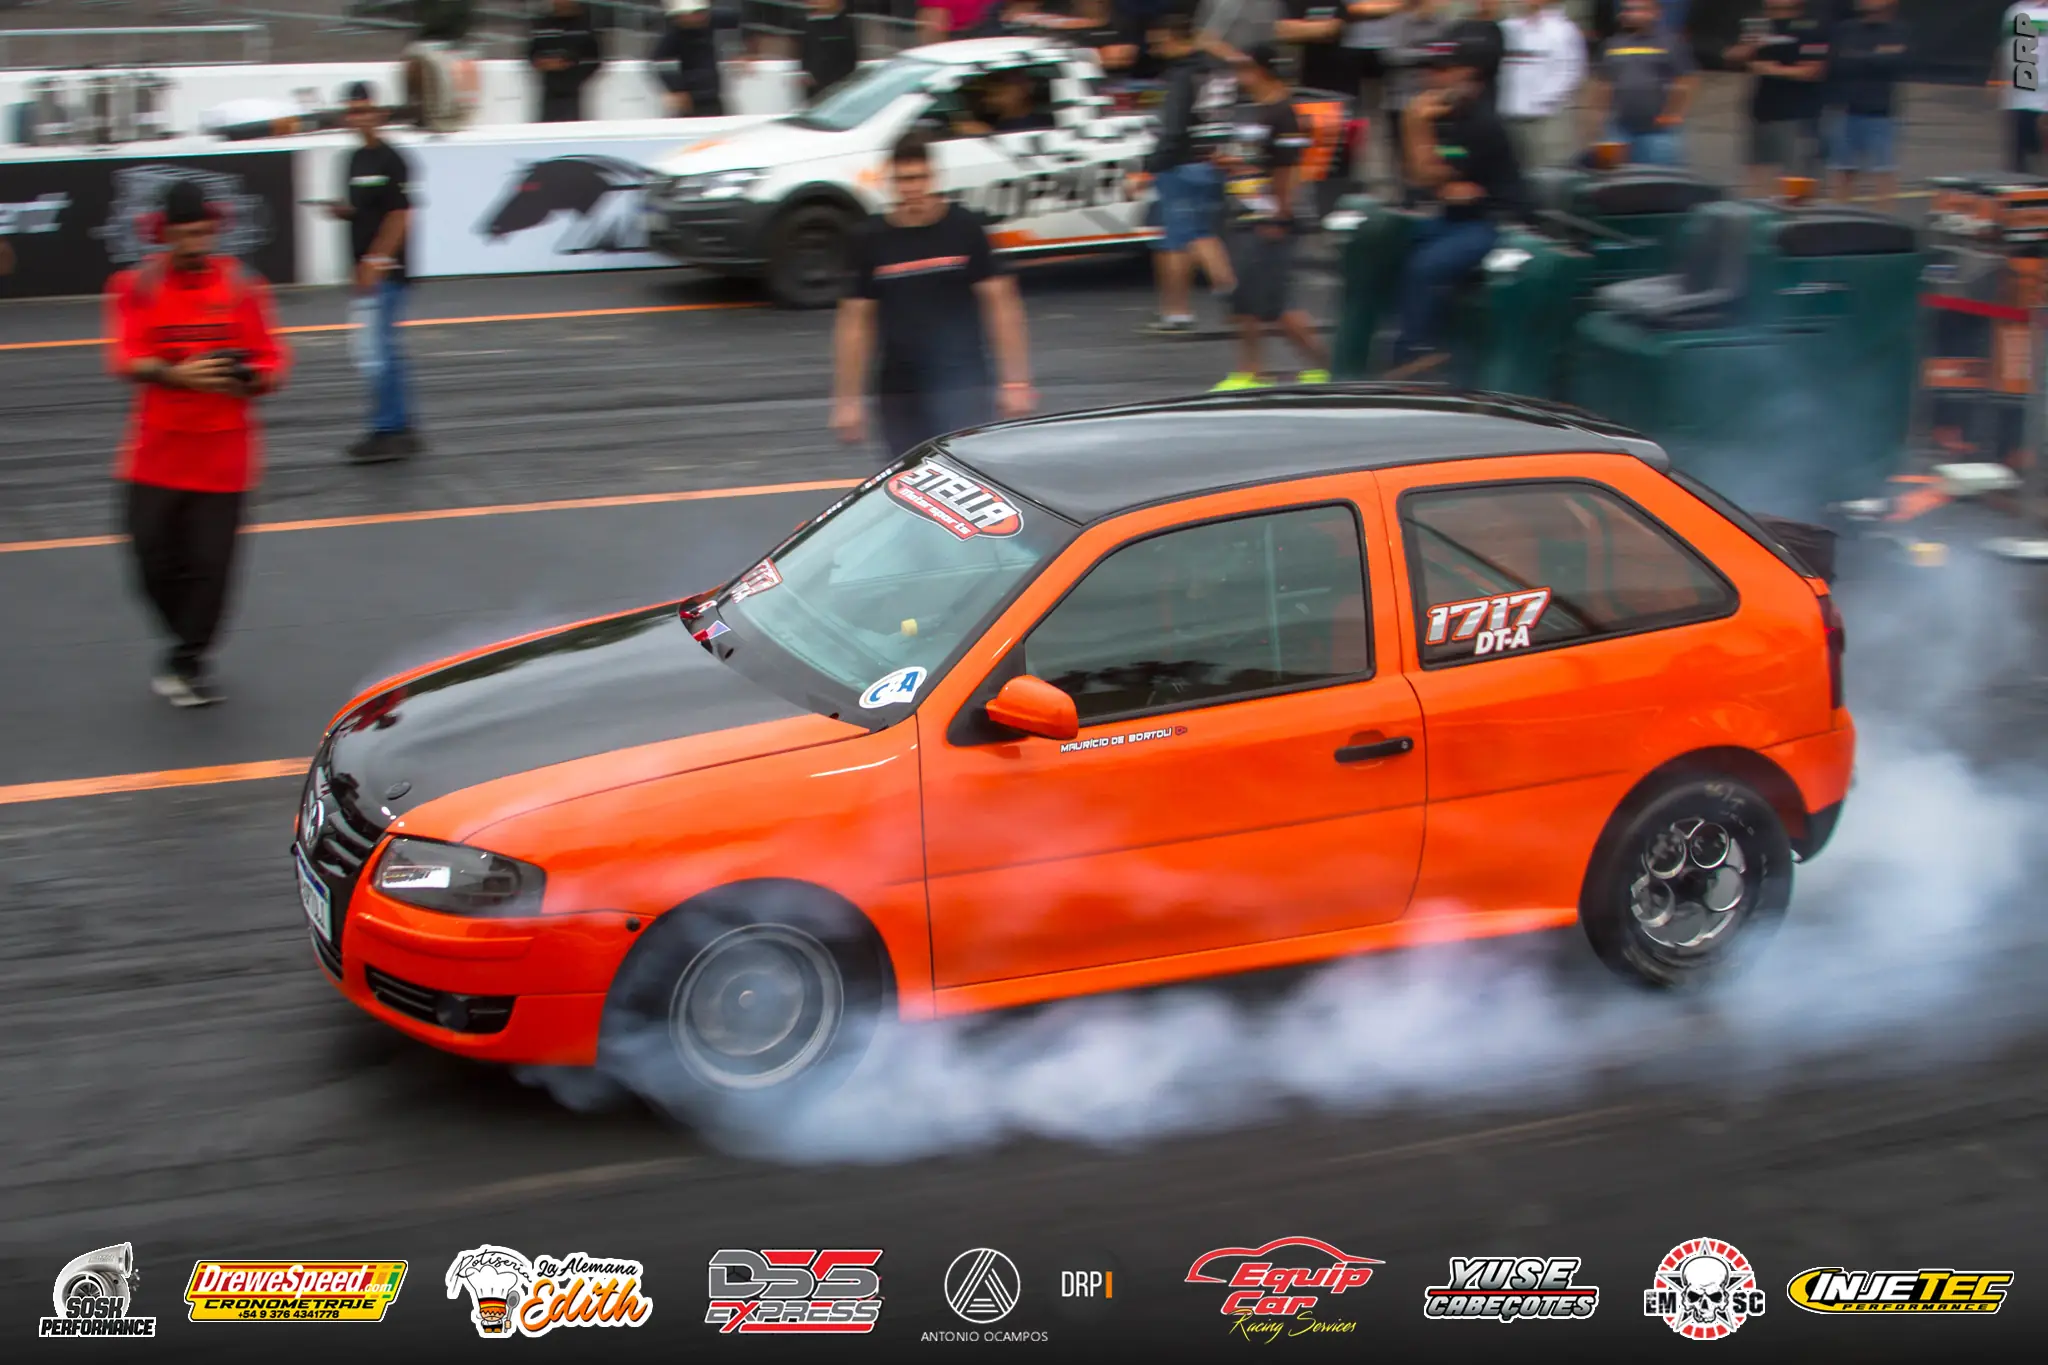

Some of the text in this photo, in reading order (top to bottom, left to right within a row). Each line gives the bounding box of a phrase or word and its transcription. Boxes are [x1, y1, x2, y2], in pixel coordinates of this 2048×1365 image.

[899, 459, 1019, 529] STELLA
[900, 487, 972, 535] Motorsports
[1426, 588, 1550, 643] 1717
[1474, 625, 1530, 655] DT-A
[869, 671, 919, 702] CA
[1060, 737, 1109, 753] MAURÍCIO
[1111, 735, 1125, 746] DE
[1128, 727, 1172, 743] BORTOLI
